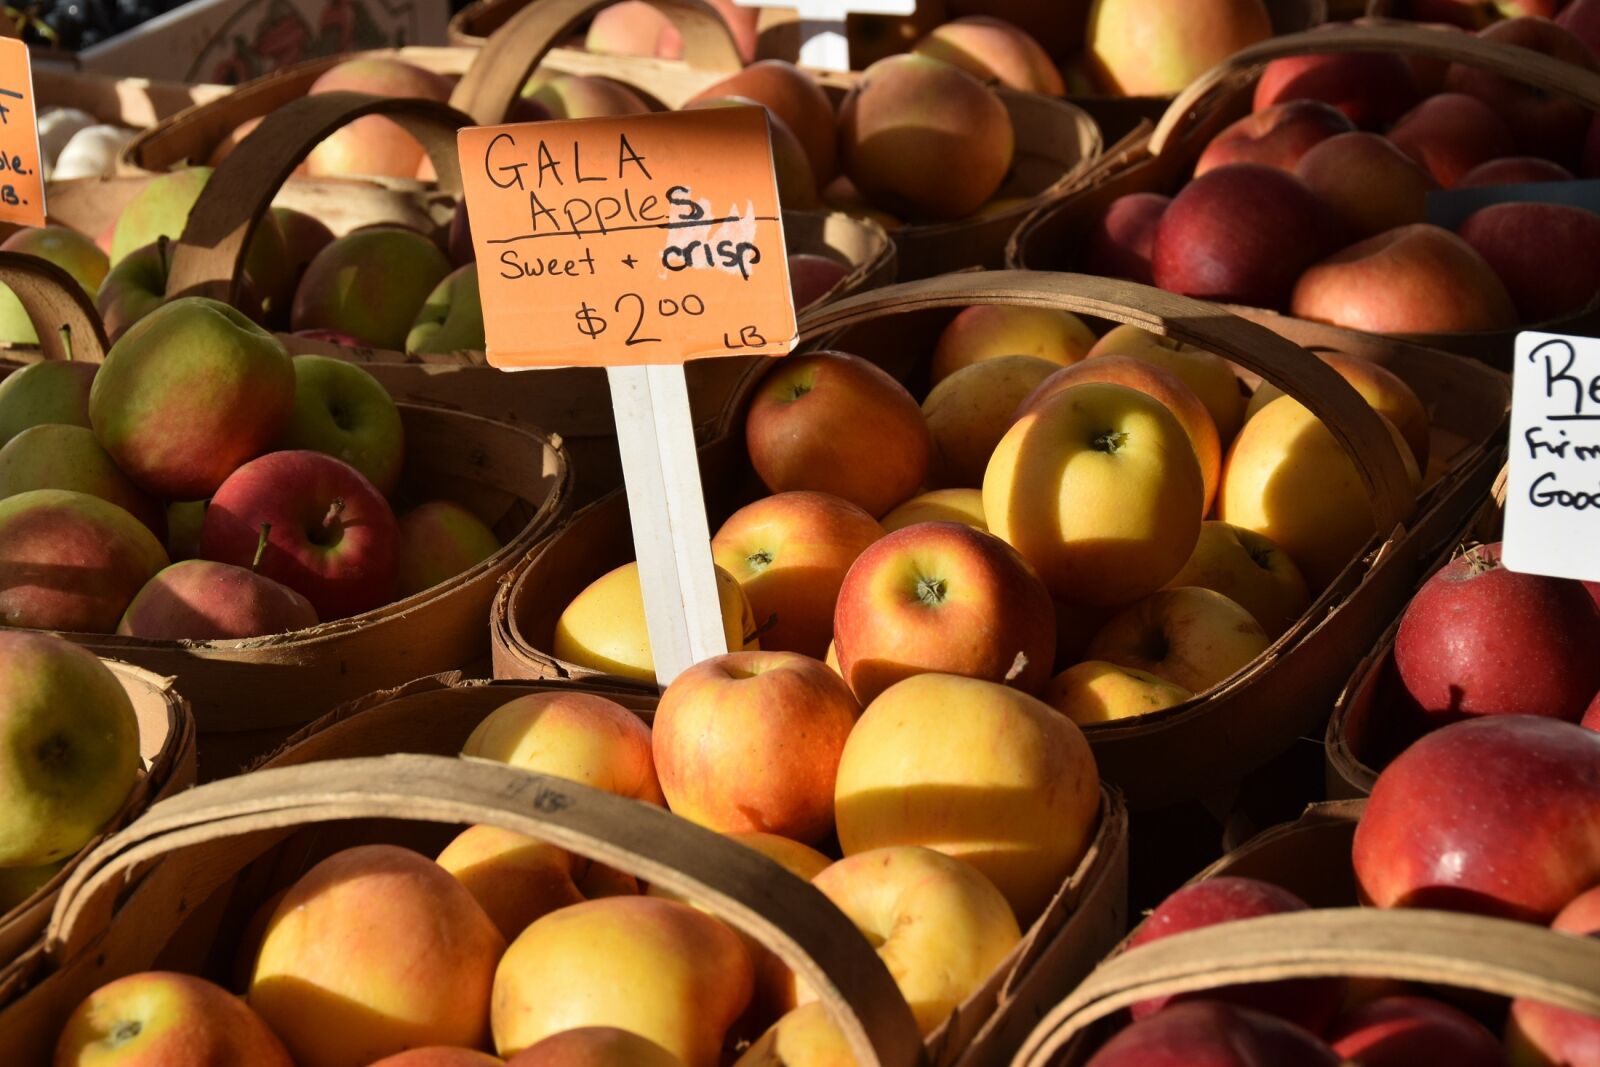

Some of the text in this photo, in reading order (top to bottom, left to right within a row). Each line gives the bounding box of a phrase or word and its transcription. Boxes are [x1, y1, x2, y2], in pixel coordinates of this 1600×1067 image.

[485, 133, 653, 191] GALA
[499, 247, 596, 279] Sweet
[661, 240, 761, 281] crisp
[723, 326, 768, 349] LB
